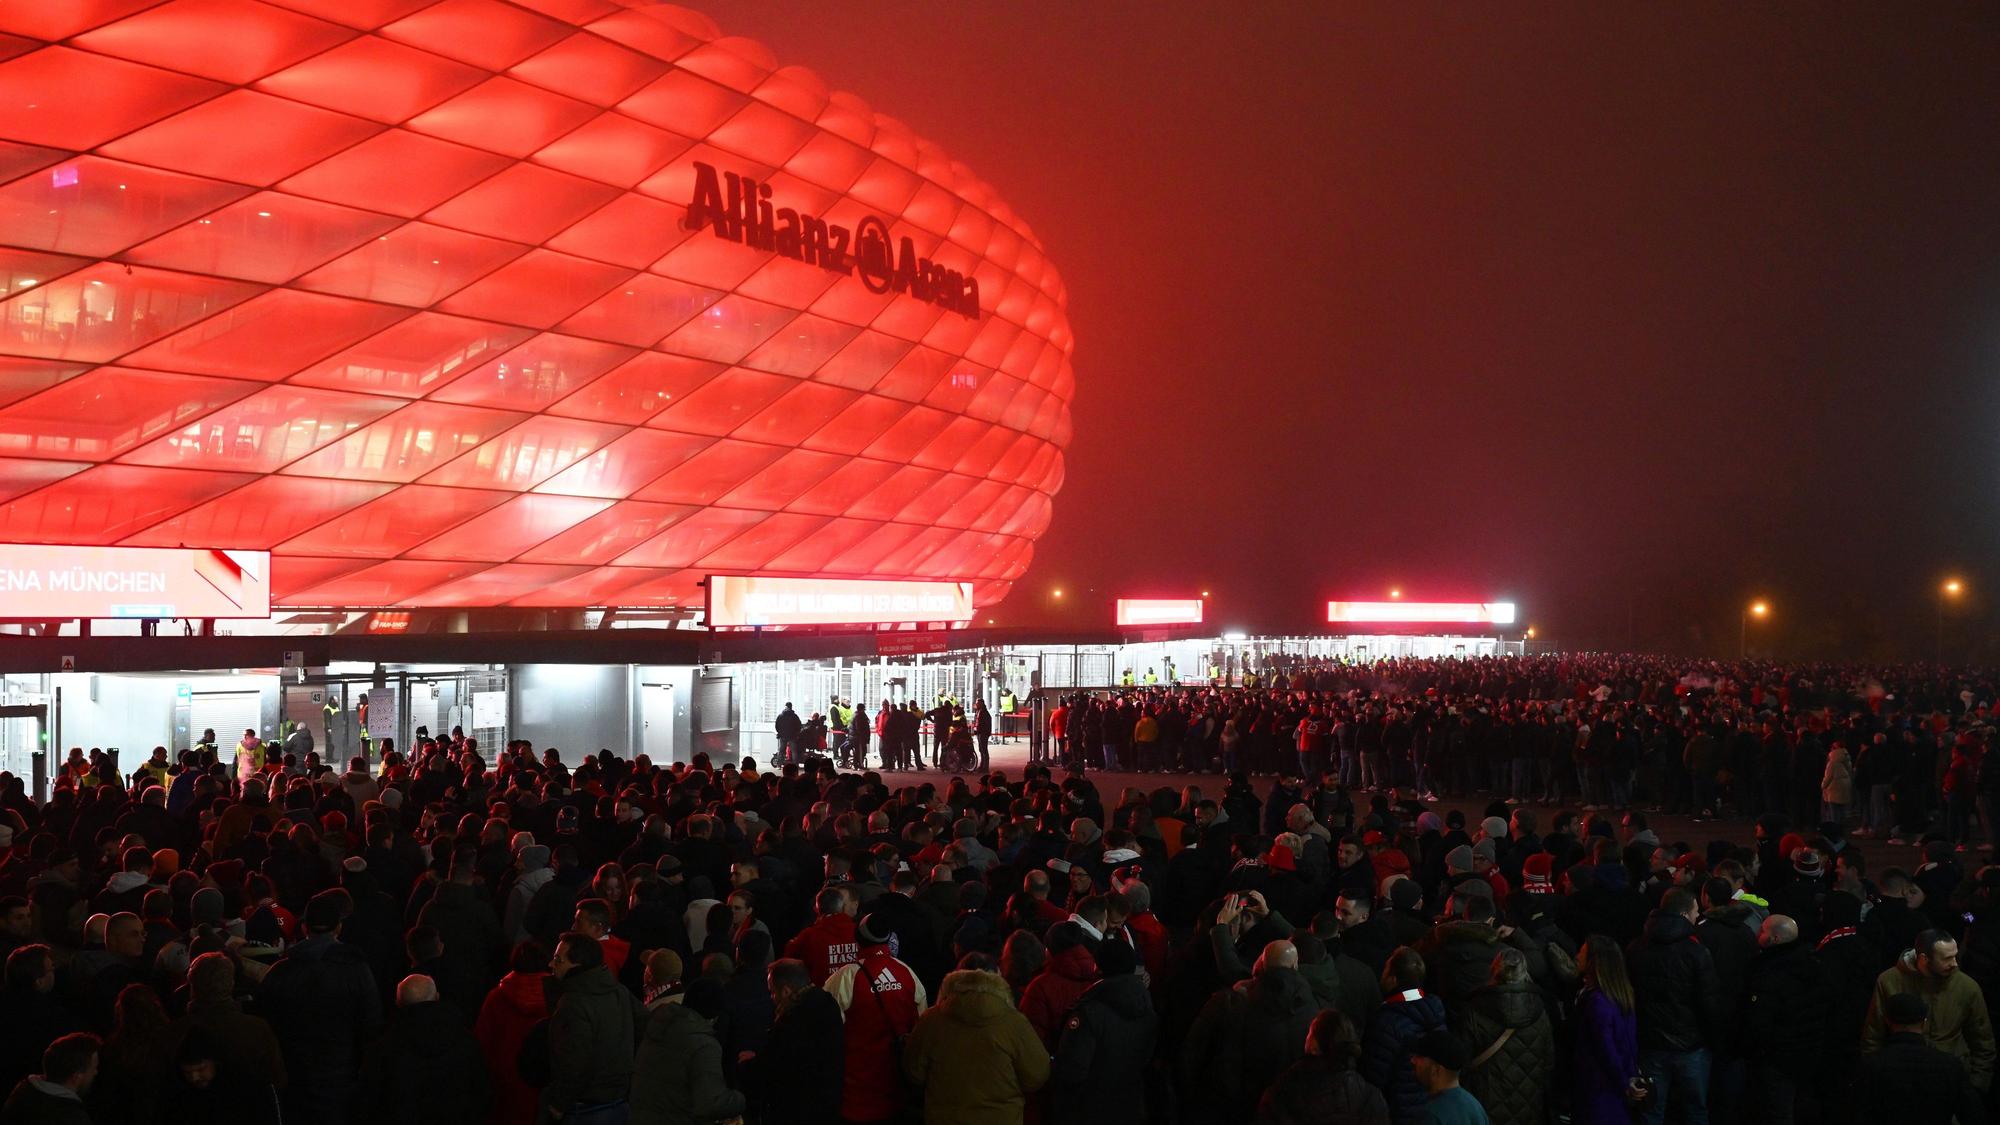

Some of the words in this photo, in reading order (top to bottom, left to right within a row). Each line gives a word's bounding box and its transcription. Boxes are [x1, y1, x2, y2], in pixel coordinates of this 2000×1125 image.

[686, 161, 852, 277] Allianz
[892, 236, 980, 321] Arena
[49, 566, 166, 592] MÜNCHEN
[313, 693, 321, 702] 43
